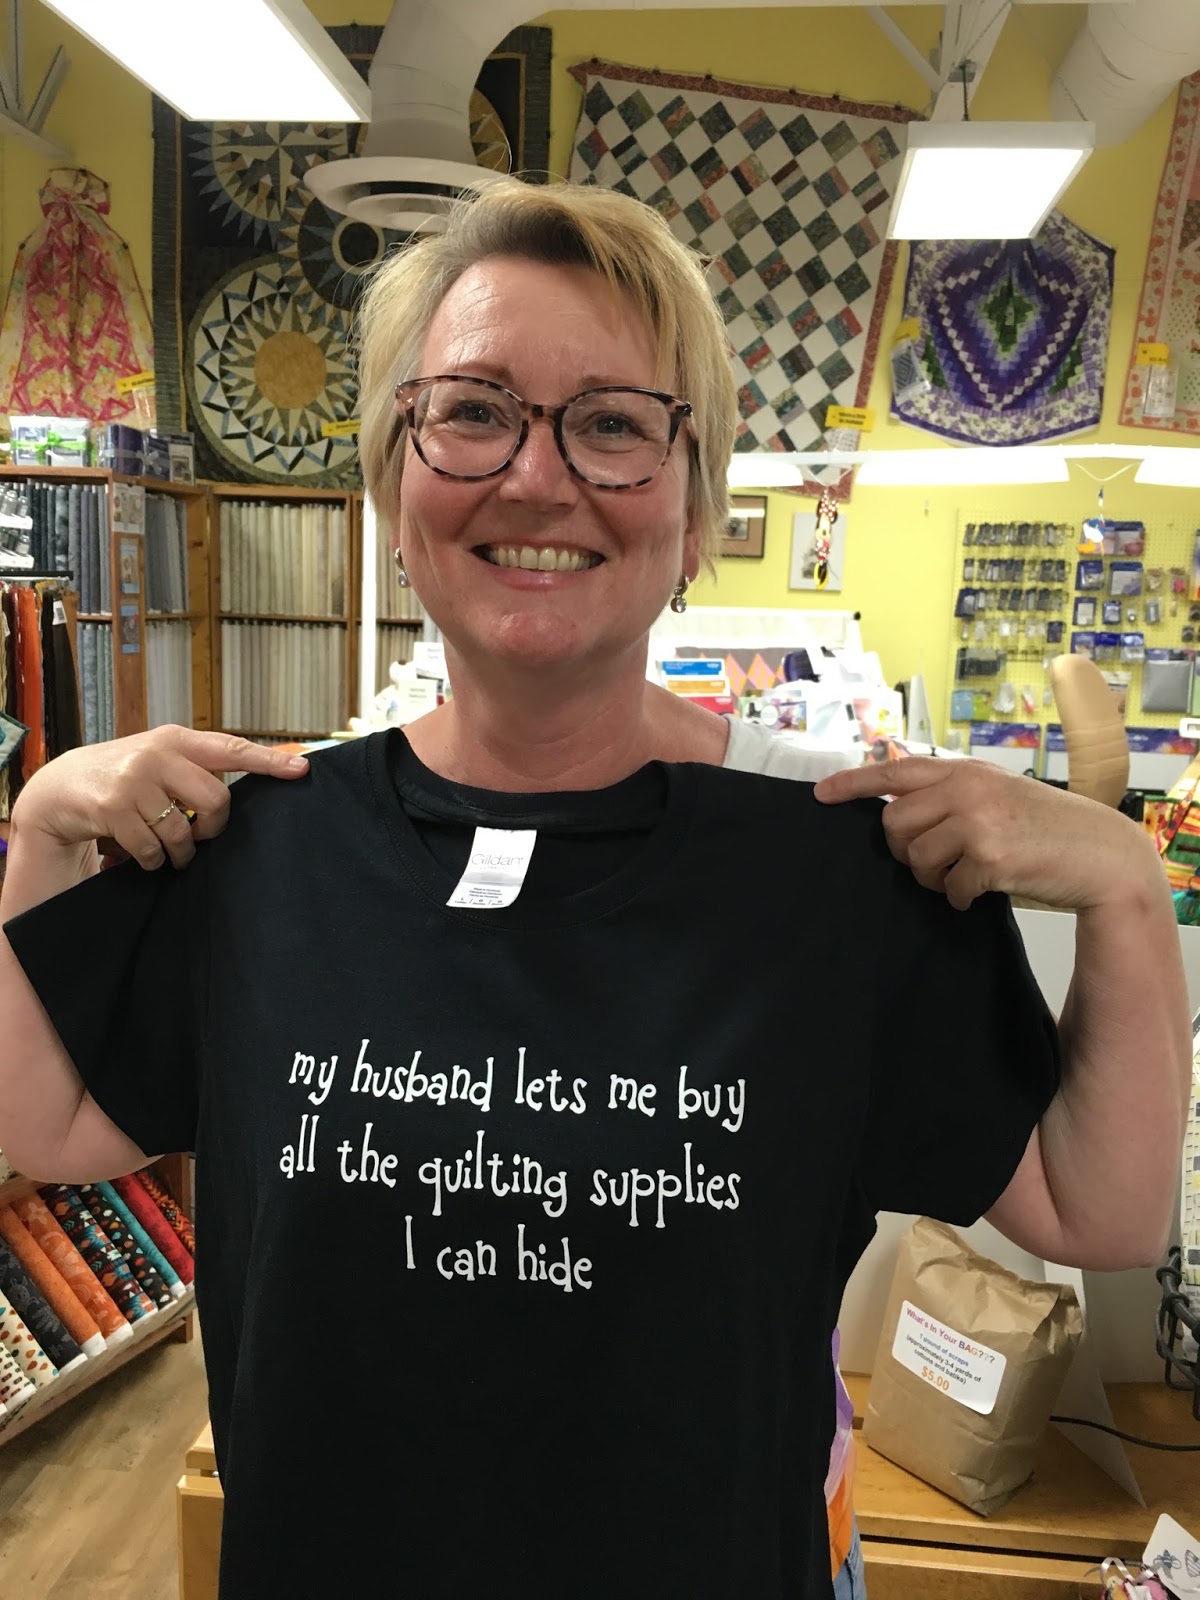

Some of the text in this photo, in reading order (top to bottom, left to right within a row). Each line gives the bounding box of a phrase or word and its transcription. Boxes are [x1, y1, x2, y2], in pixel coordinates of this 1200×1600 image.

[471, 853, 521, 866] Gildan
[289, 1039, 745, 1132] my husband lets me buy
[280, 1114, 741, 1228] all the quilting supplies
[405, 1215, 592, 1292] I can hide
[906, 1308, 928, 1328] What's
[930, 1324, 937, 1333] In
[939, 1329, 957, 1345] Your
[906, 1334, 982, 1383] (approximately 3-4 yards of
[914, 1349, 967, 1385] cottons and batiks)
[923, 1337, 941, 1351] pound
[948, 1353, 969, 1367] scraps
[921, 1366, 950, 1391] $5.00
